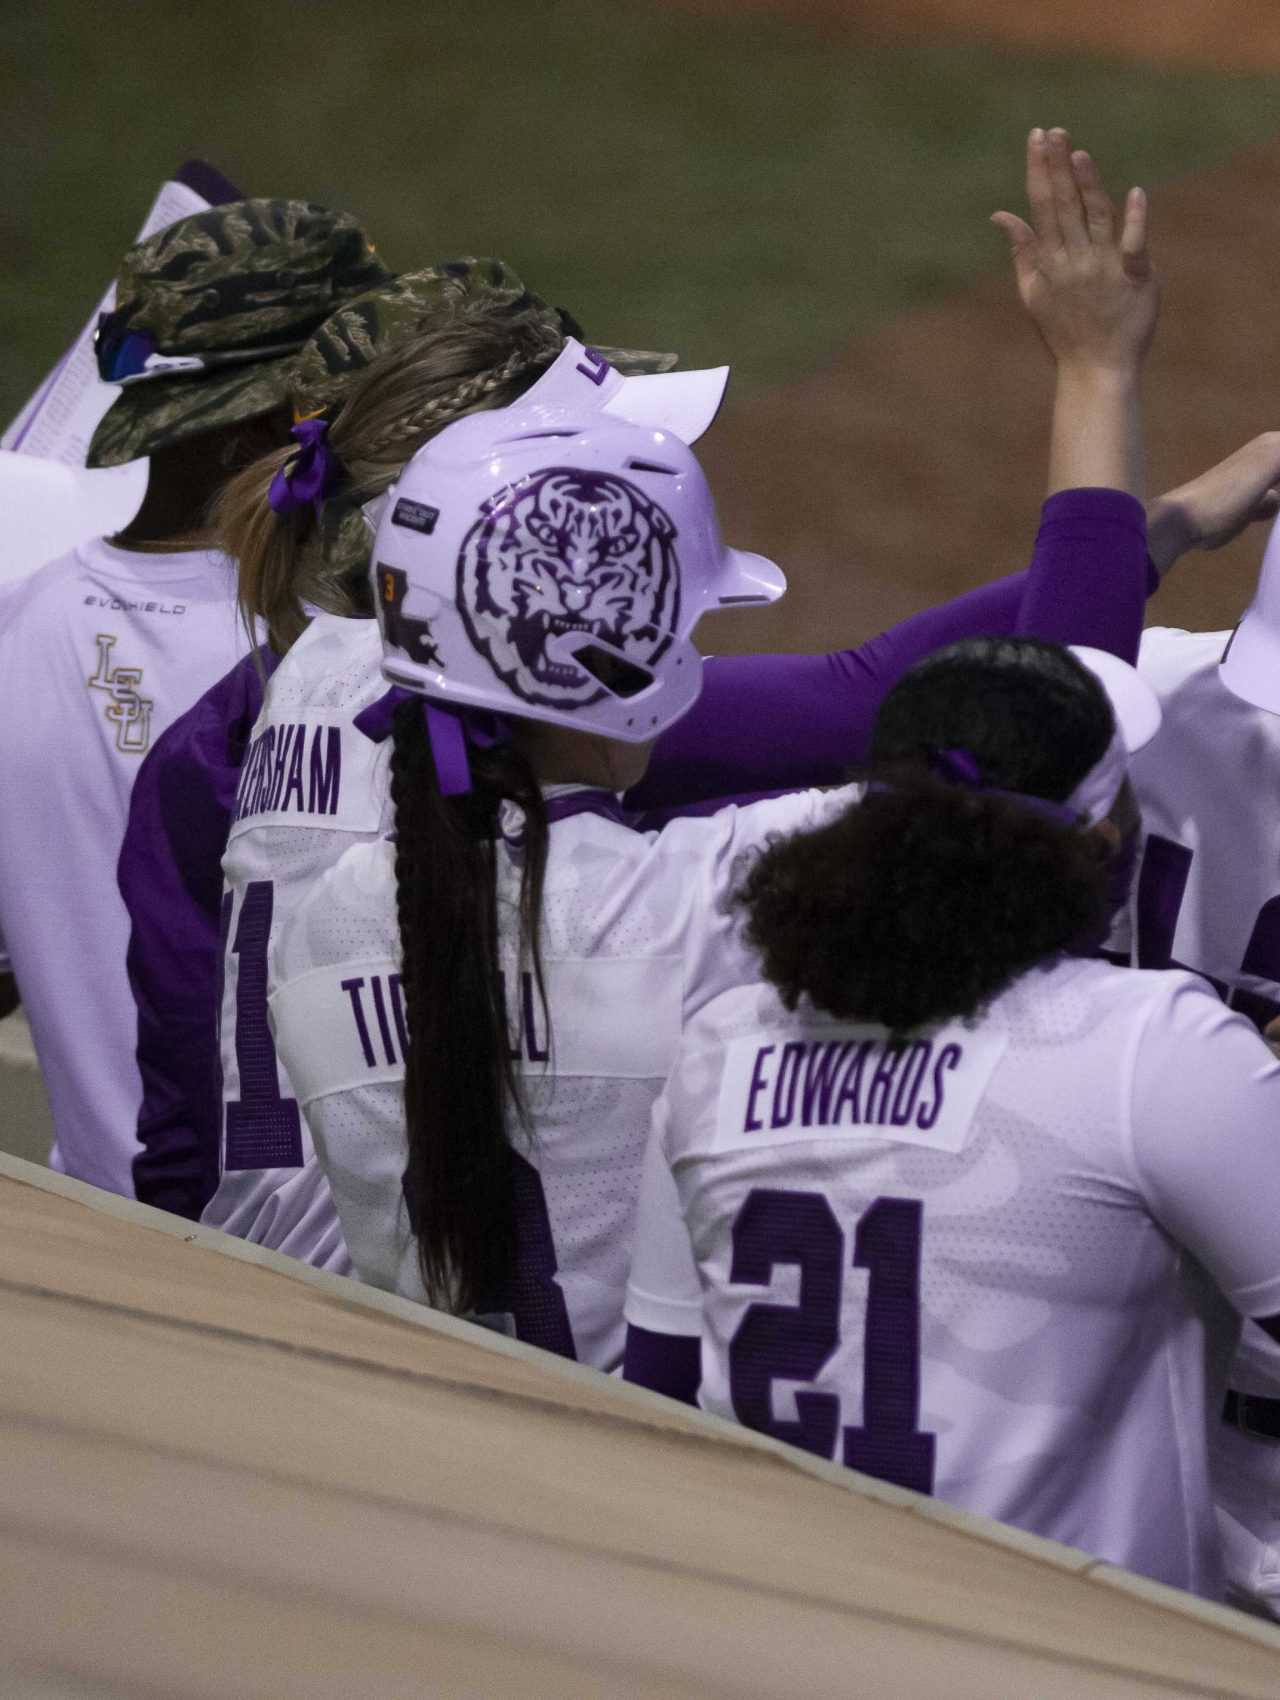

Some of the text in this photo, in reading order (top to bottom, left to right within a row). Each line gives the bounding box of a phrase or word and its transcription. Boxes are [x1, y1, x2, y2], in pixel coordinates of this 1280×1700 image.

[88, 632, 154, 753] LSU
[222, 880, 304, 1171] 1
[743, 1038, 963, 1133] EDWARDS
[730, 1188, 936, 1496] 21
